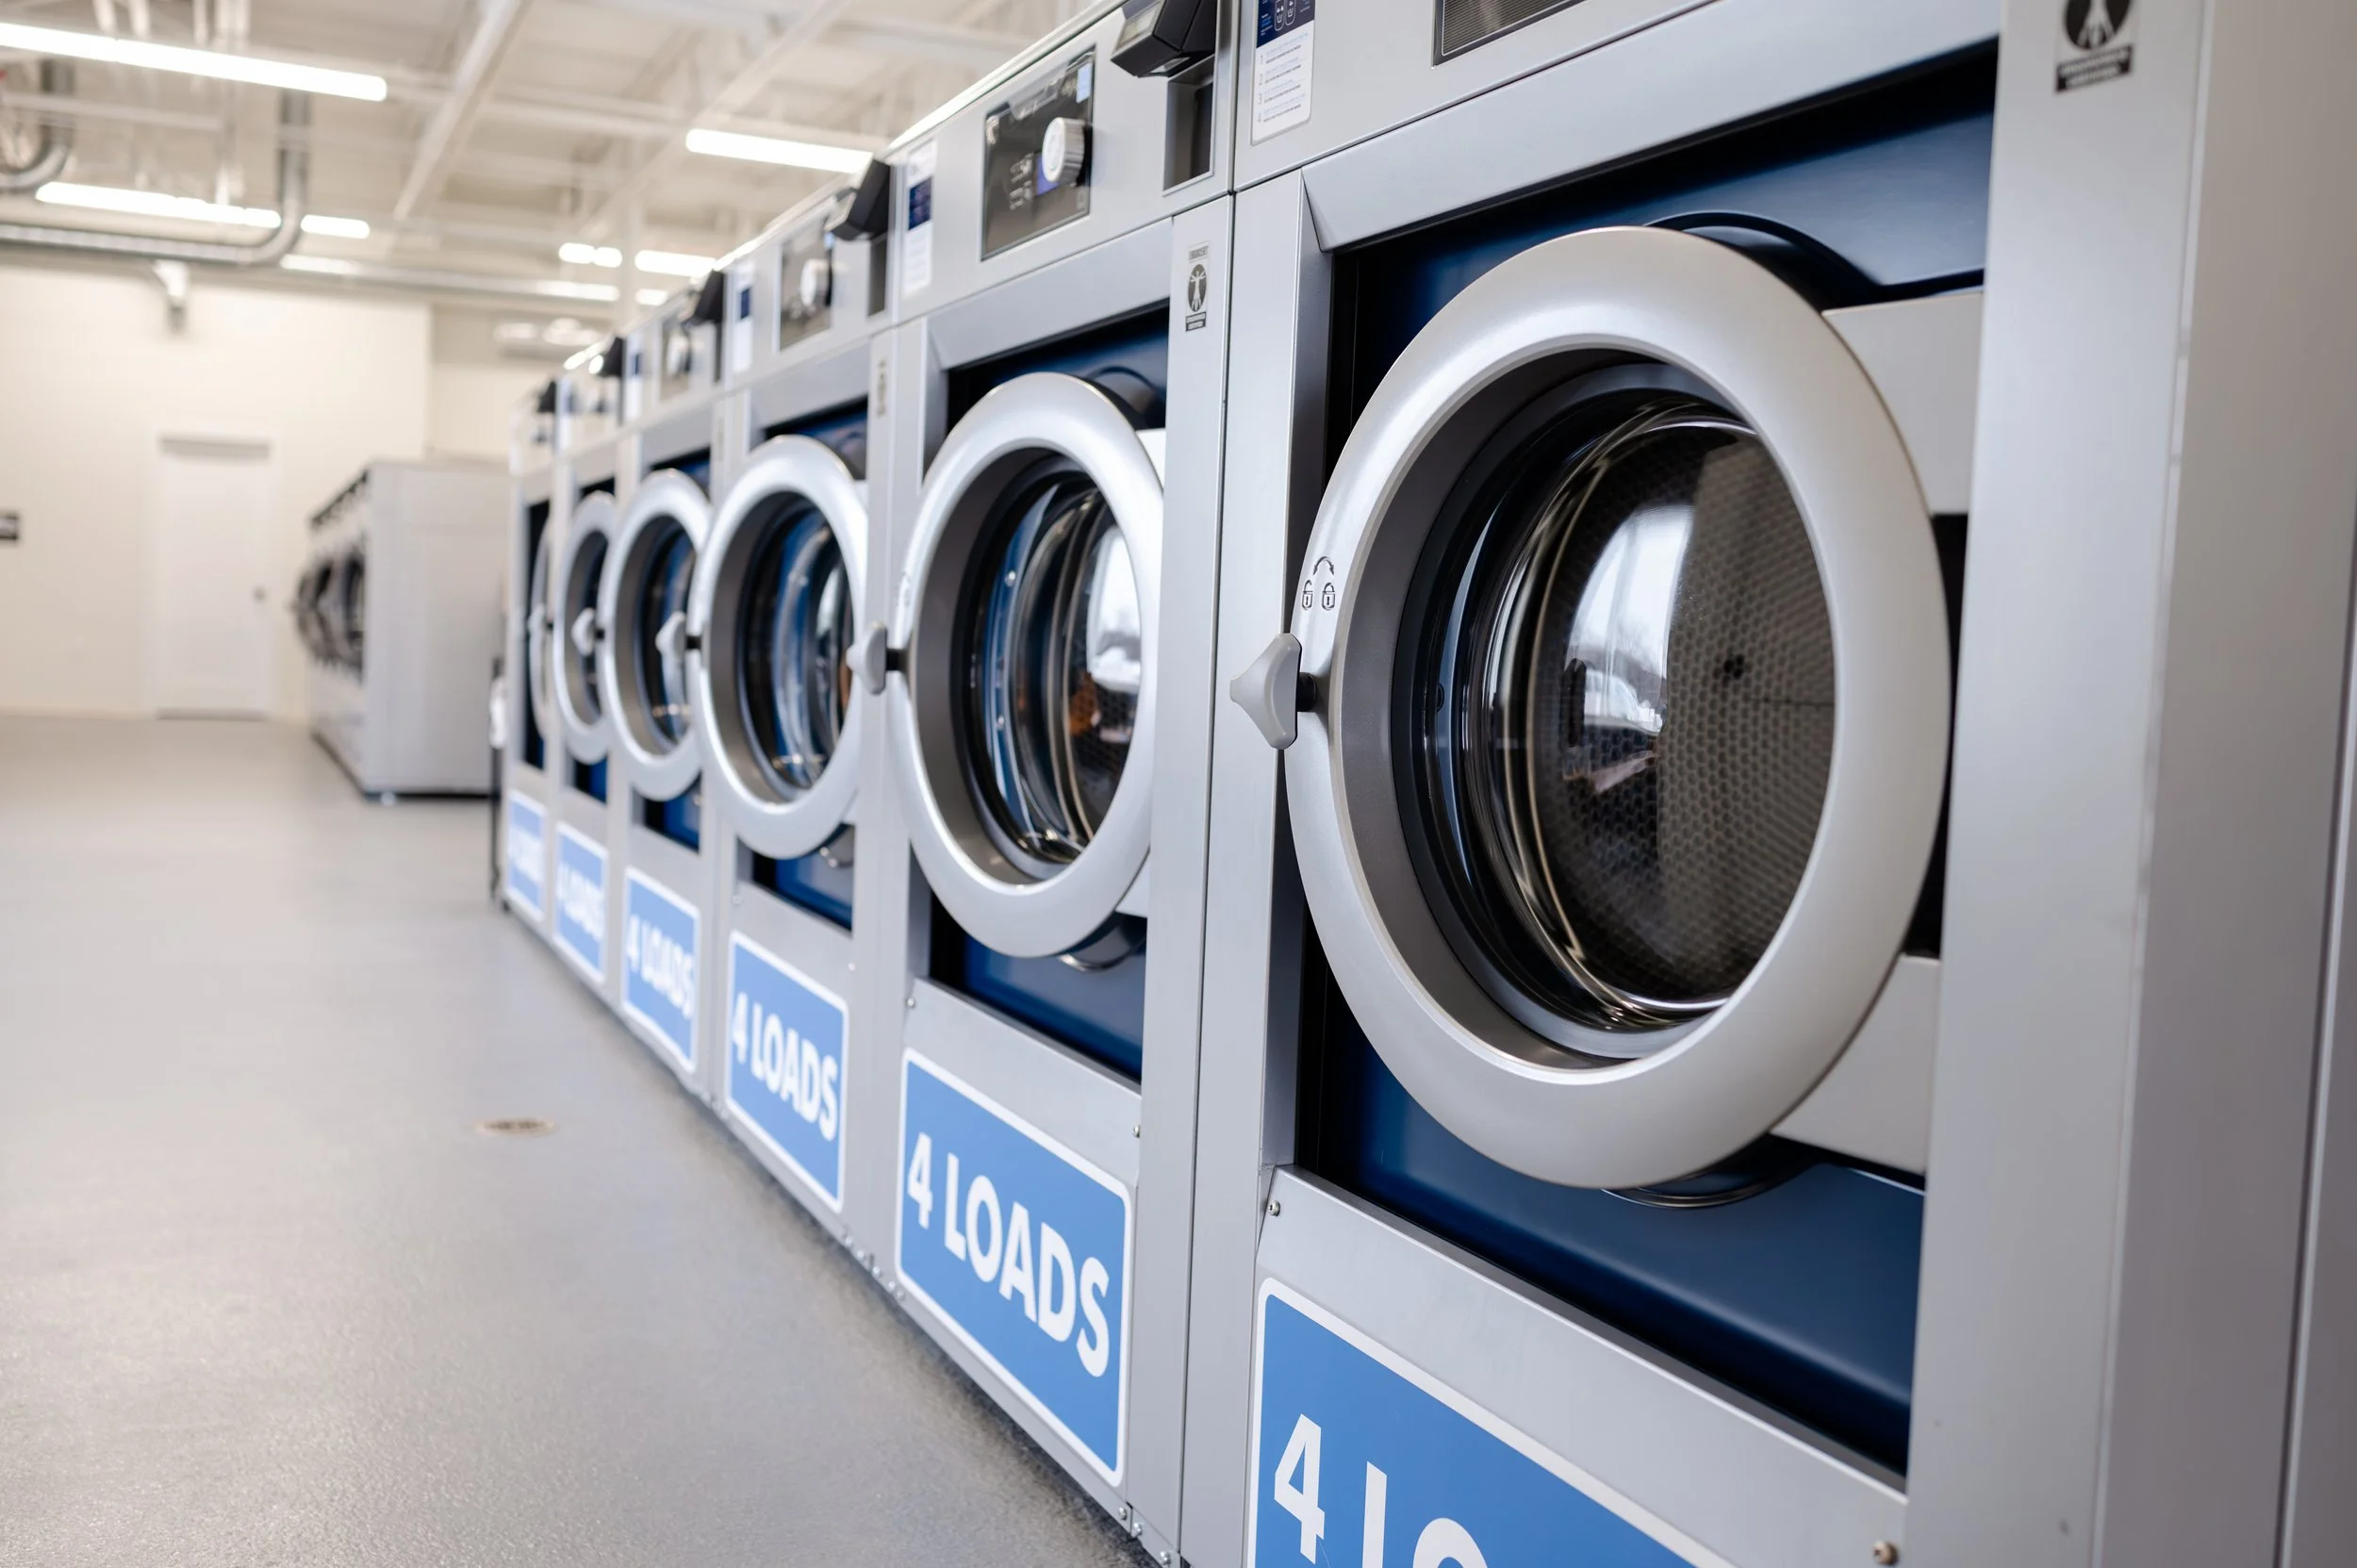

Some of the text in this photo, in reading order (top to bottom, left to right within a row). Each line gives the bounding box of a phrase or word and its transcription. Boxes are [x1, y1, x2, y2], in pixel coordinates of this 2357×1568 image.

[732, 993, 839, 1142] 4 LOADS
[907, 1132, 1112, 1378] 4 LOADS
[1273, 1412, 1326, 1564] 4
